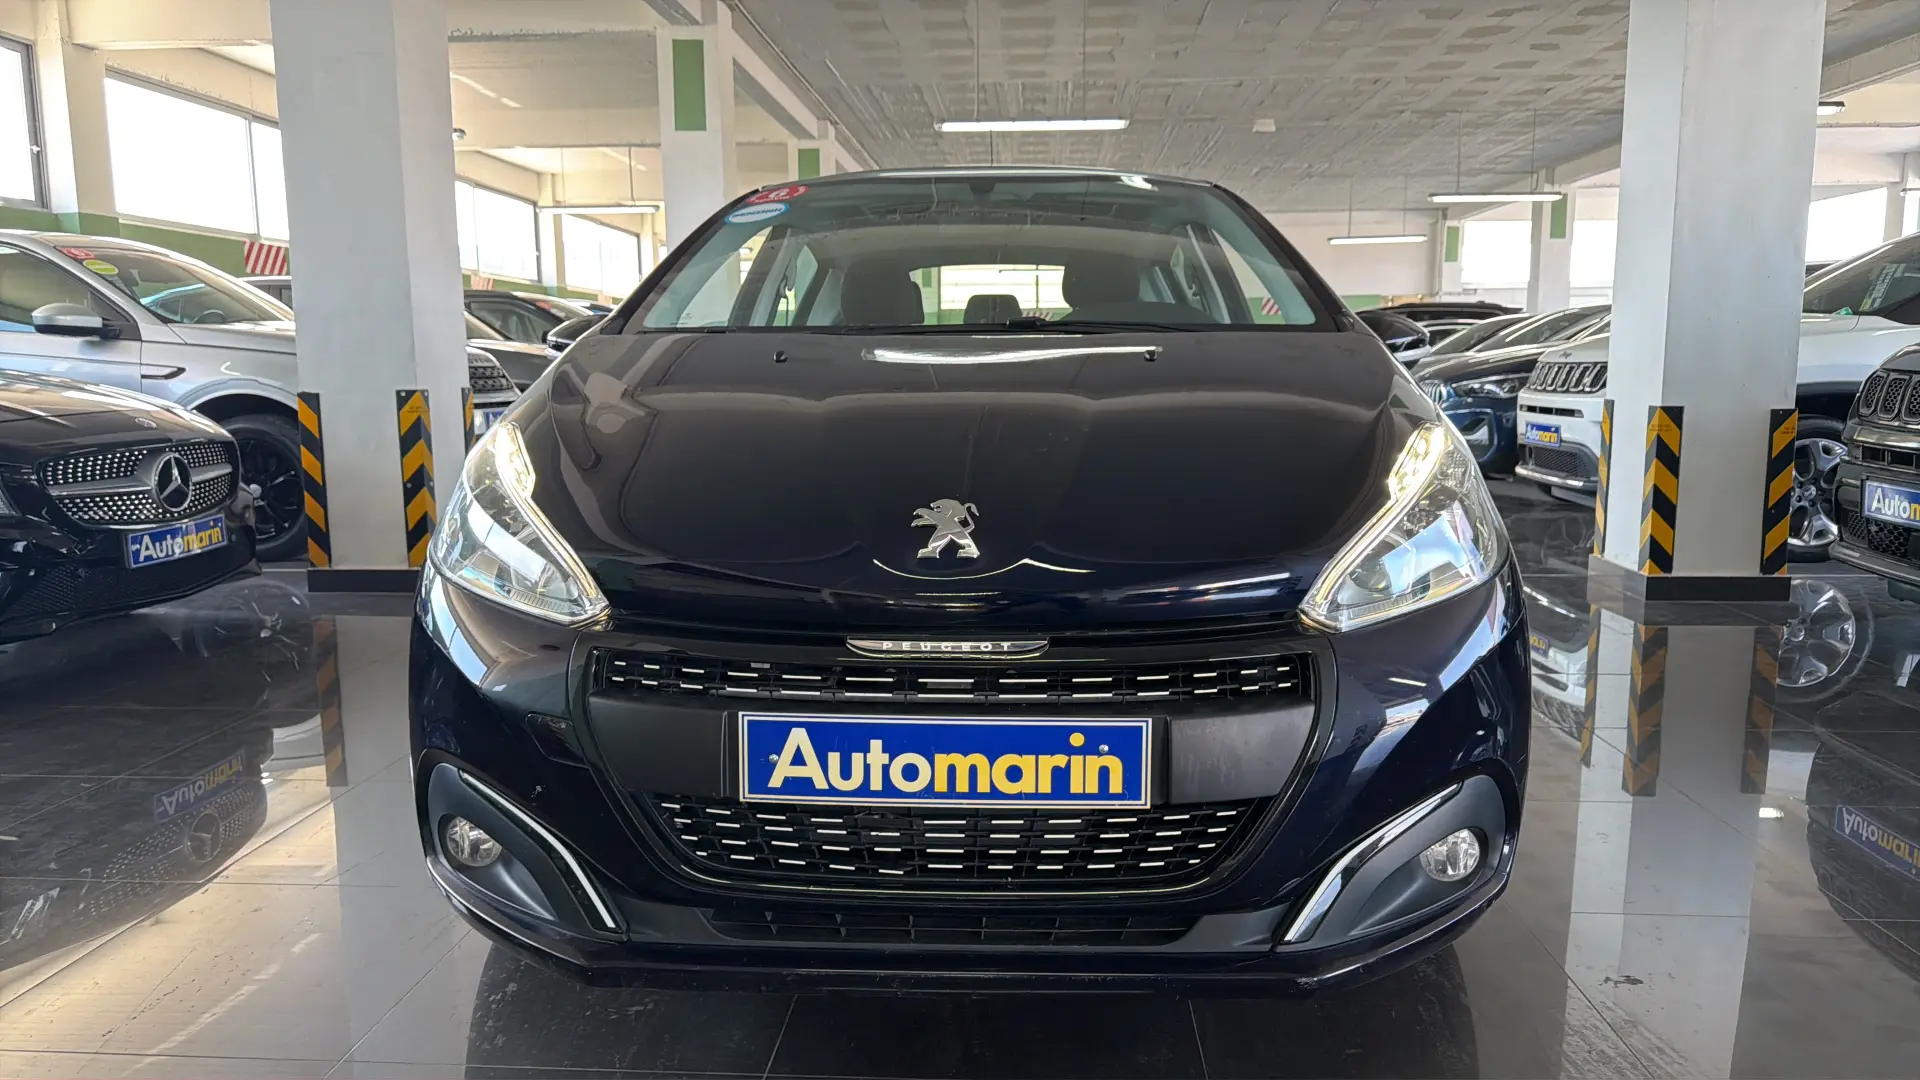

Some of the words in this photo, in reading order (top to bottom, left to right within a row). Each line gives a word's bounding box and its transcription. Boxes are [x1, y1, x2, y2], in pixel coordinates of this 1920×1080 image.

[139, 521, 222, 562] Automarin
[882, 642, 1011, 651] PEUGEOT
[767, 727, 1123, 794] Automarin
